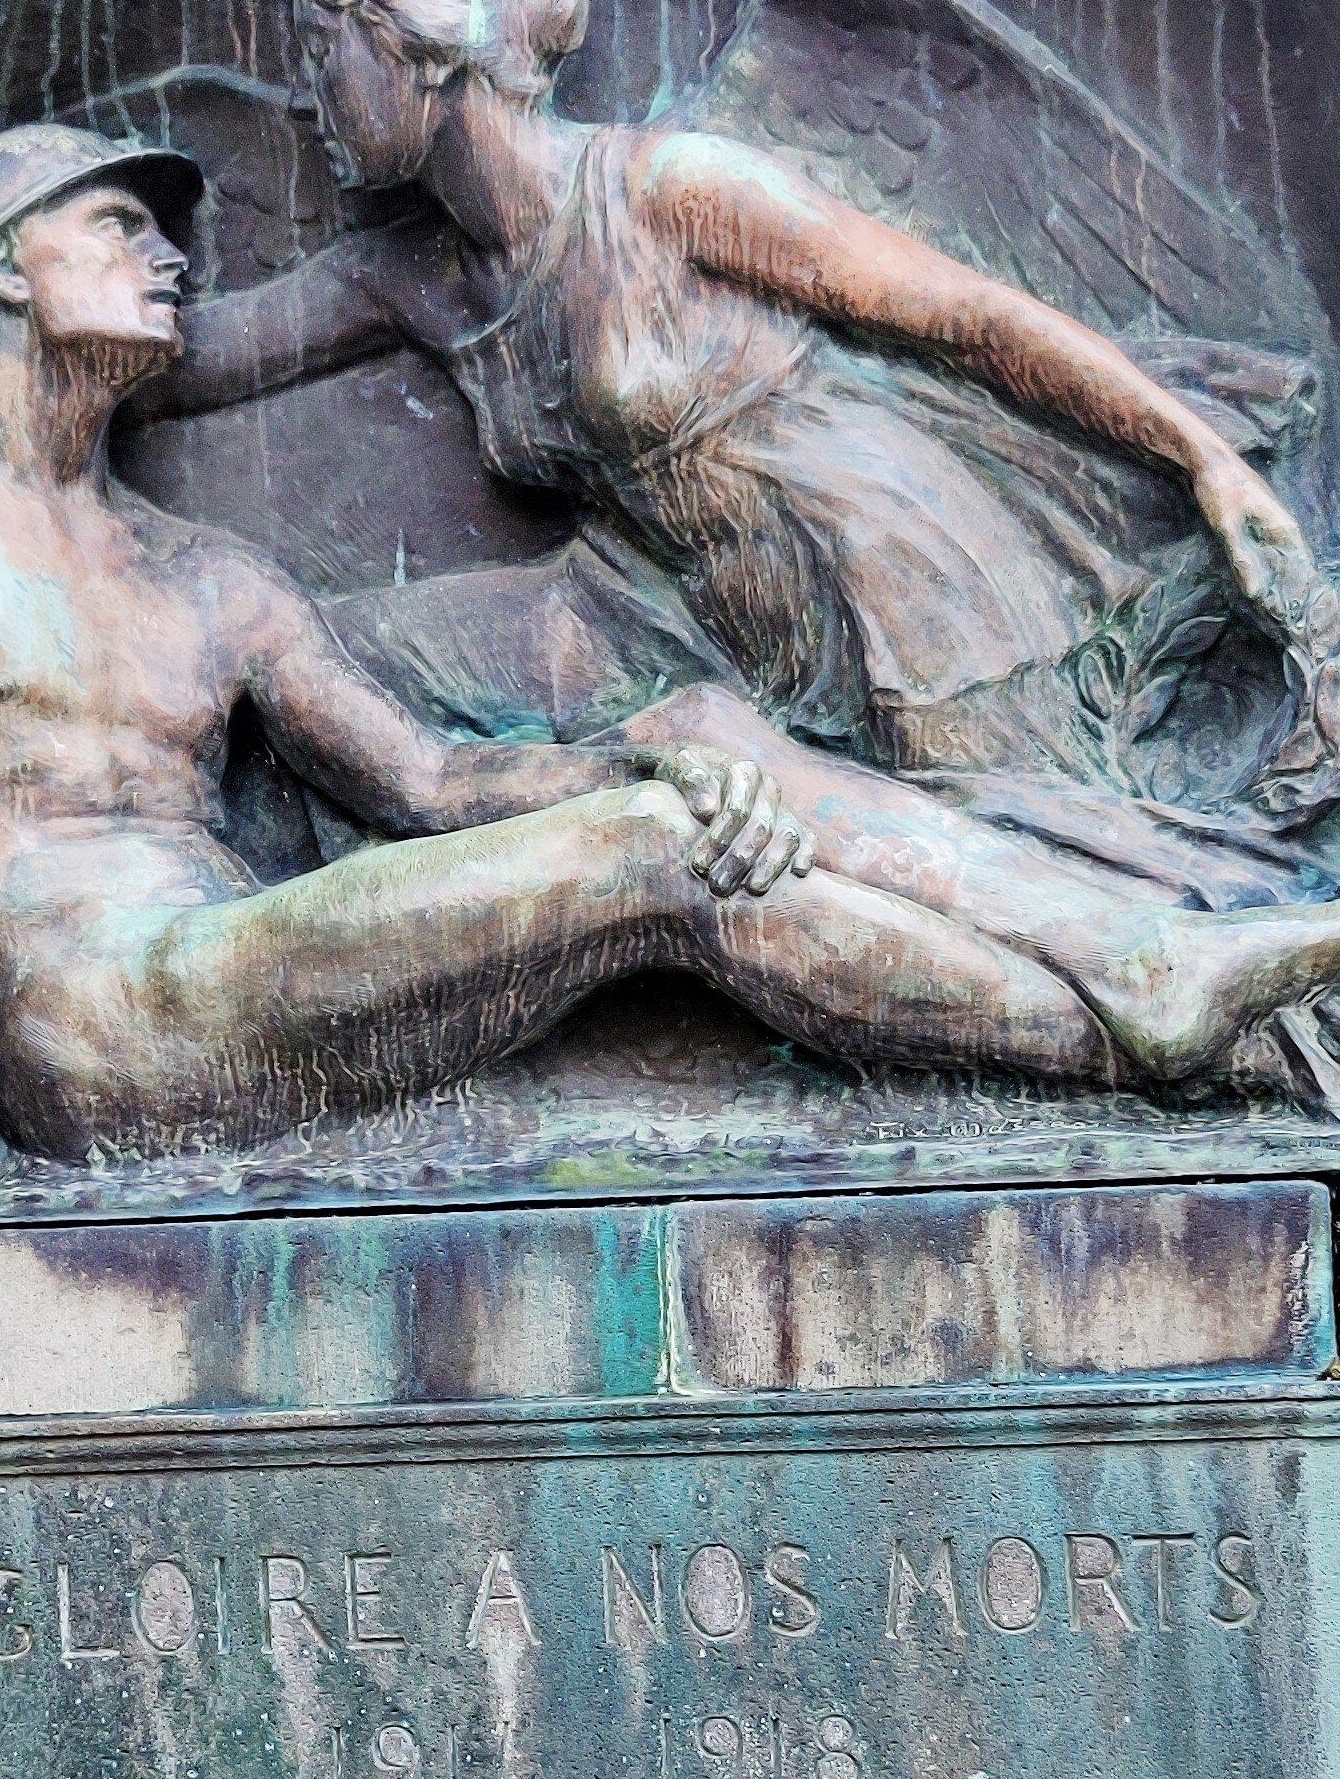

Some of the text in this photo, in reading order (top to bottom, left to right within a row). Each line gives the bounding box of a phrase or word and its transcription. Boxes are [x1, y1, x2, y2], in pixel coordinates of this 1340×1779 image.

[465, 1547, 544, 1650] A
[599, 1541, 820, 1642] NOS
[884, 1529, 1259, 1640] MORTS
